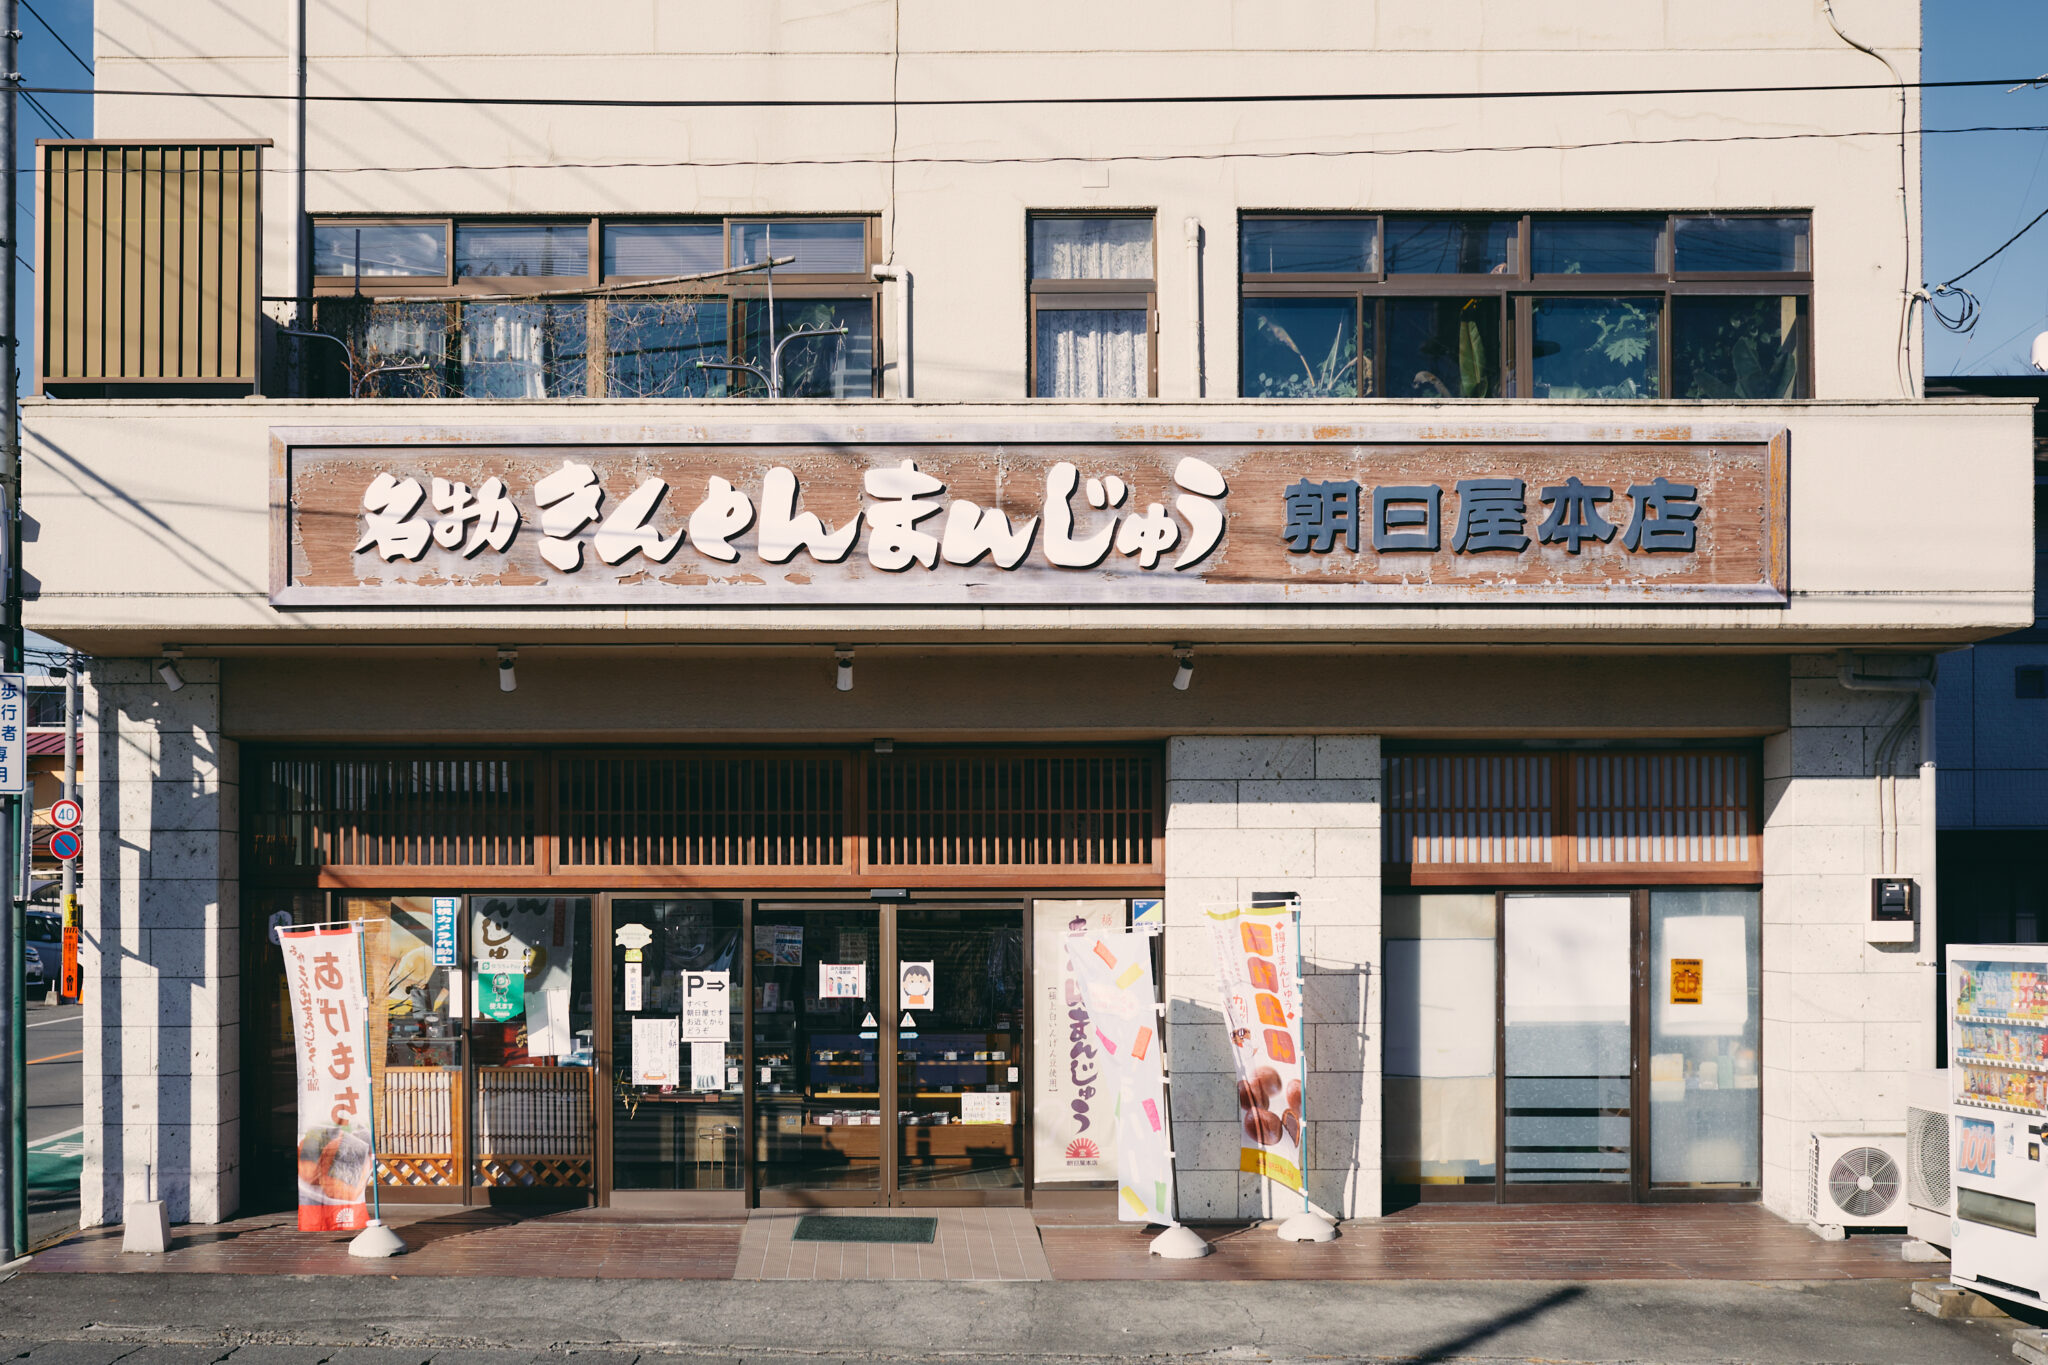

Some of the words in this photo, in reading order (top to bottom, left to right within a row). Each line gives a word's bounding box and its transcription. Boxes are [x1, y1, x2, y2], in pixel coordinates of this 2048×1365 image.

[1283, 476, 1700, 553] 朝日屋本店
[57, 808, 75, 821] 40
[436, 899, 454, 964] 監視カメラ作動中
[688, 976, 704, 997] P
[687, 1000, 708, 1008] すべて
[686, 1009, 723, 1017] 朝日屋です
[687, 1018, 724, 1026] お近くから
[687, 1027, 710, 1035] どうぞ
